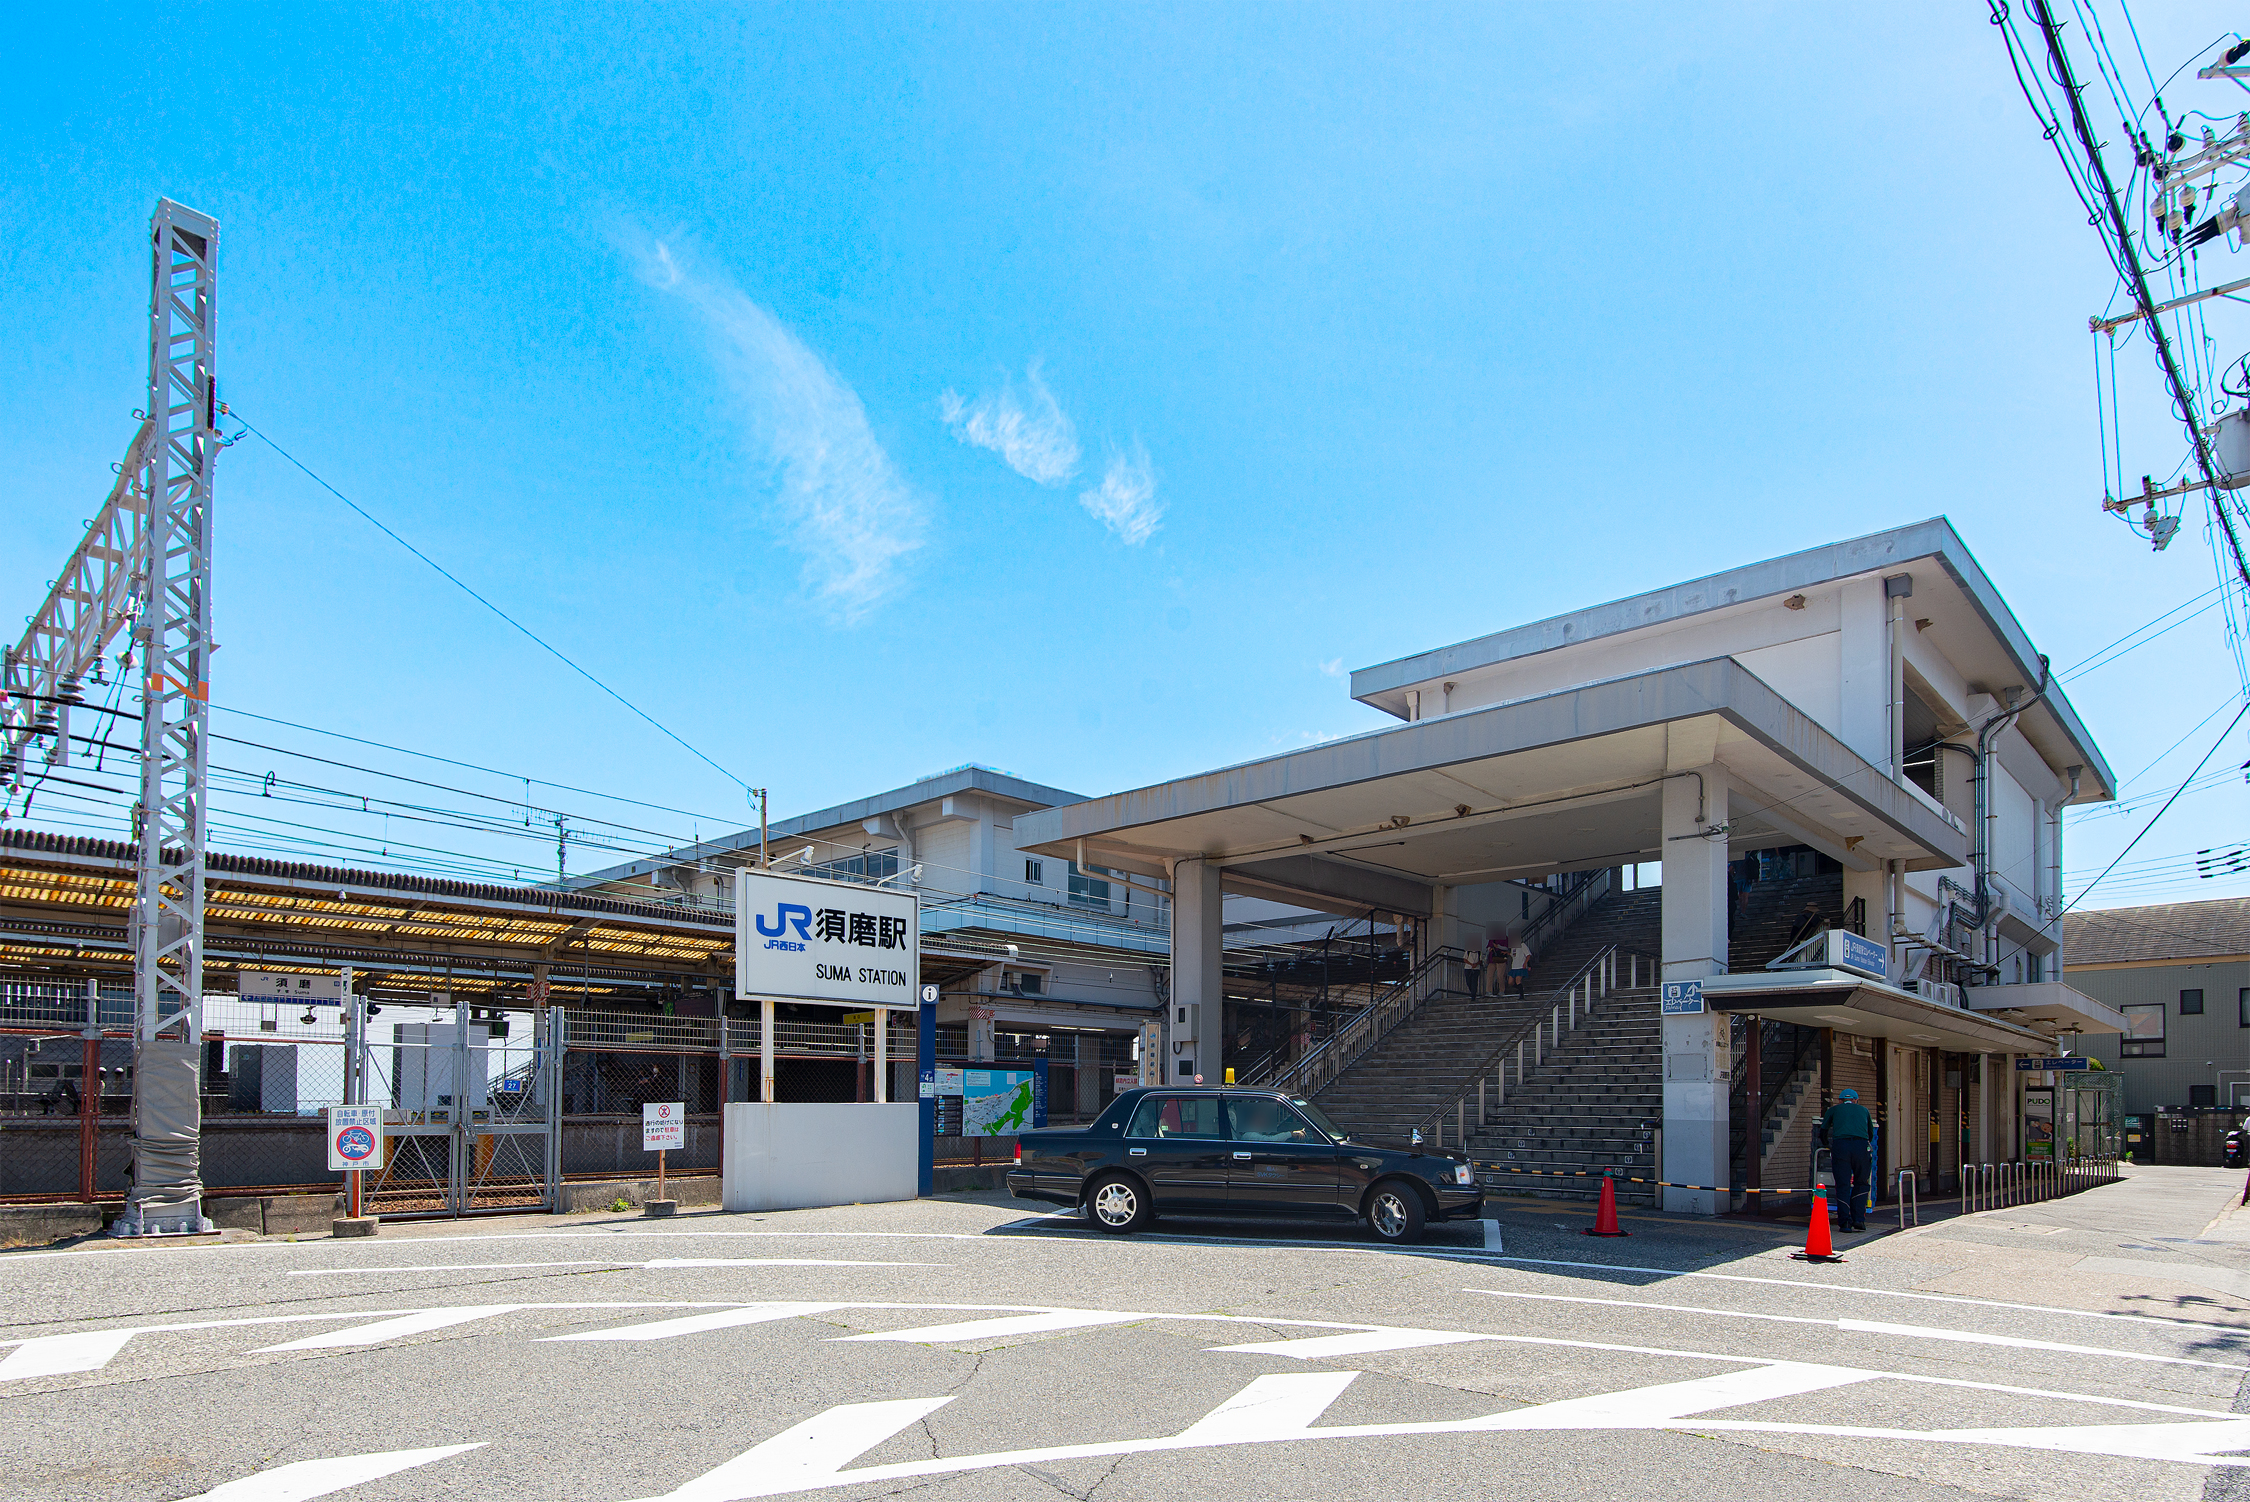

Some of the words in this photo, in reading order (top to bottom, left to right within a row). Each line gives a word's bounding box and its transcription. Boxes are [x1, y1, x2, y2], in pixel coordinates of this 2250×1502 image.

[756, 902, 812, 941] JR
[815, 908, 907, 951] 須磨駅
[764, 939, 806, 953] JR西日本
[816, 963, 852, 982] SUMA
[858, 967, 907, 987] STATION
